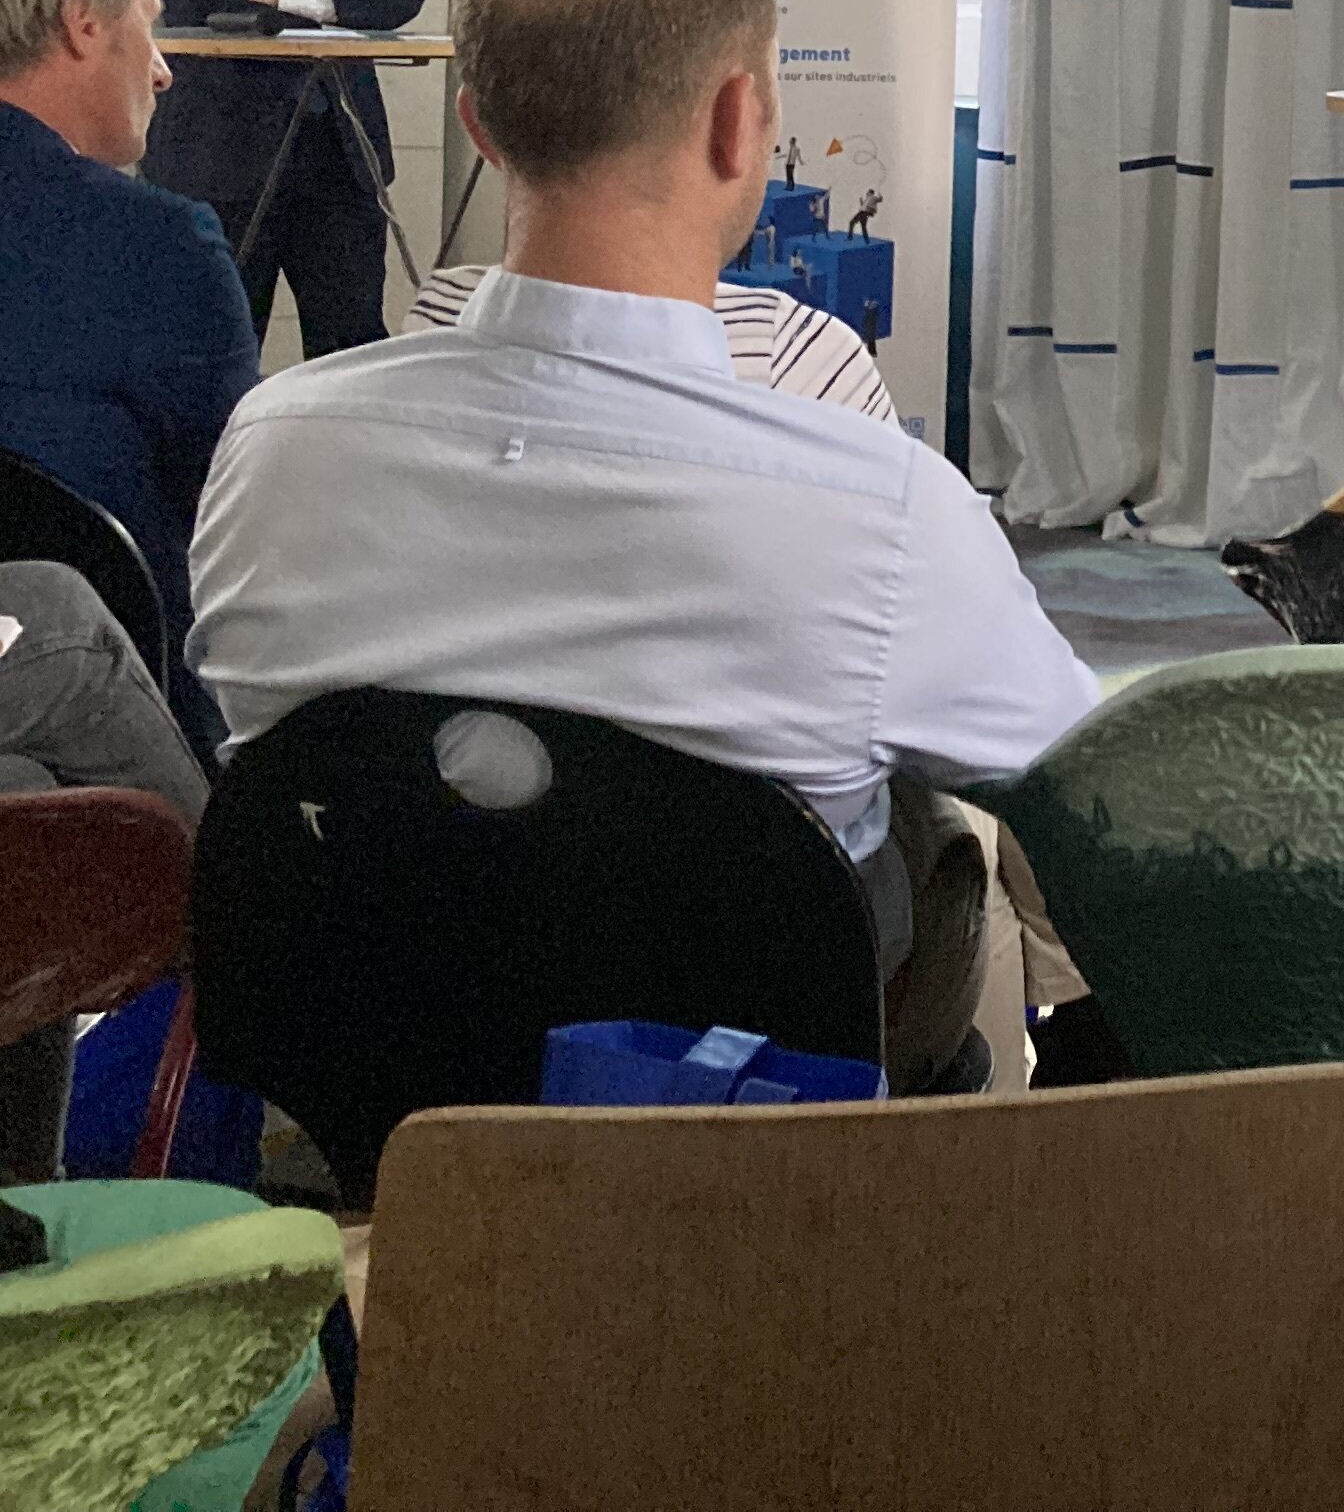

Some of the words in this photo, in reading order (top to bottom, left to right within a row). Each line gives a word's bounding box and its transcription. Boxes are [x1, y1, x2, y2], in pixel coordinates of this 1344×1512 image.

[780, 48, 850, 64] gement
[784, 73, 802, 81] sur
[805, 72, 832, 81] sites
[836, 72, 896, 82] industriels
